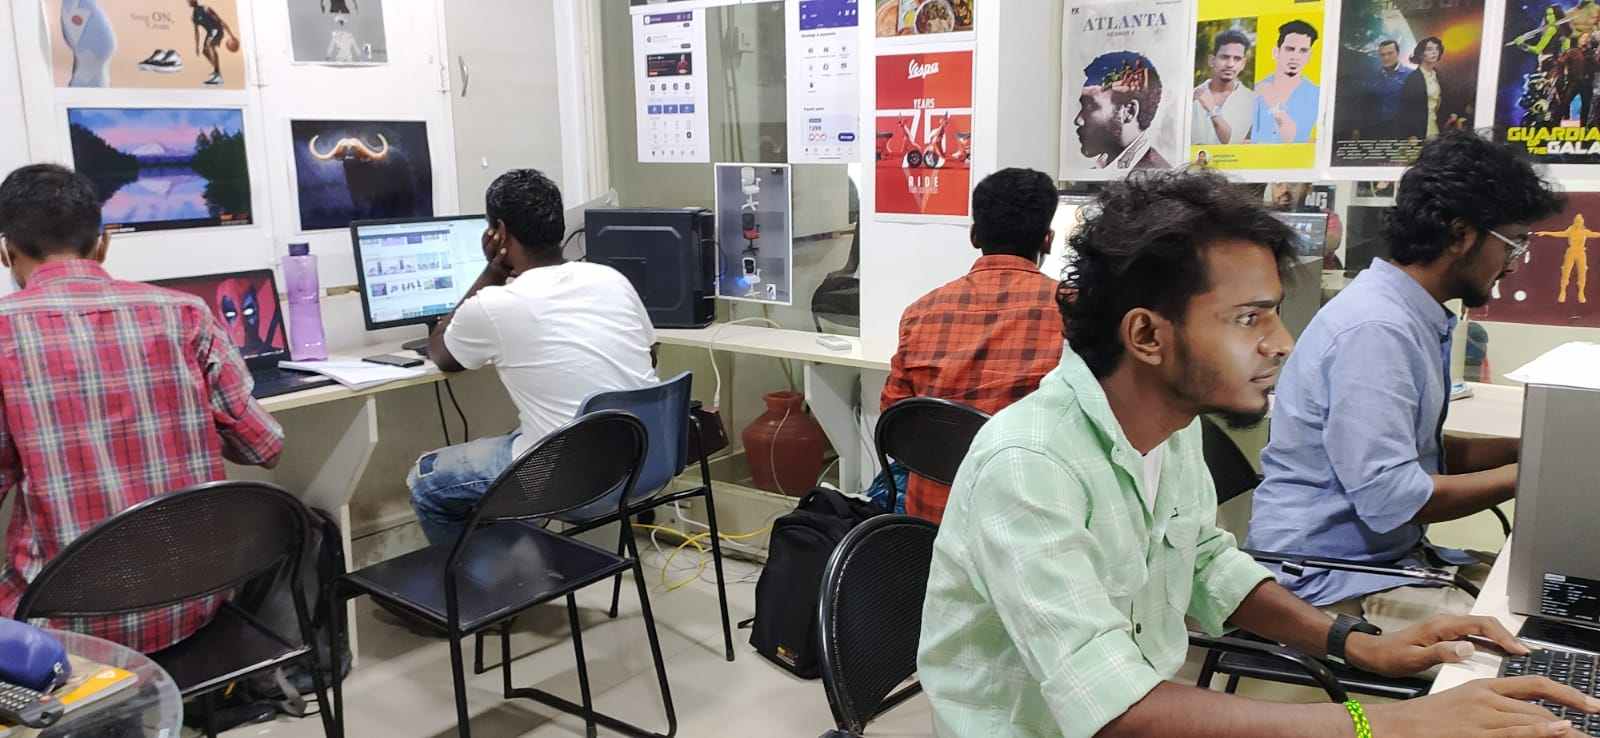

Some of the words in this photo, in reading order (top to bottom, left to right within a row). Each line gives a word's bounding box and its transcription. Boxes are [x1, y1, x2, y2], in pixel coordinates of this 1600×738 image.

[1082, 12, 1167, 32] ATLANTA
[908, 59, 940, 79] Vespa
[913, 97, 935, 109] YEARS
[908, 175, 939, 188] RIDE
